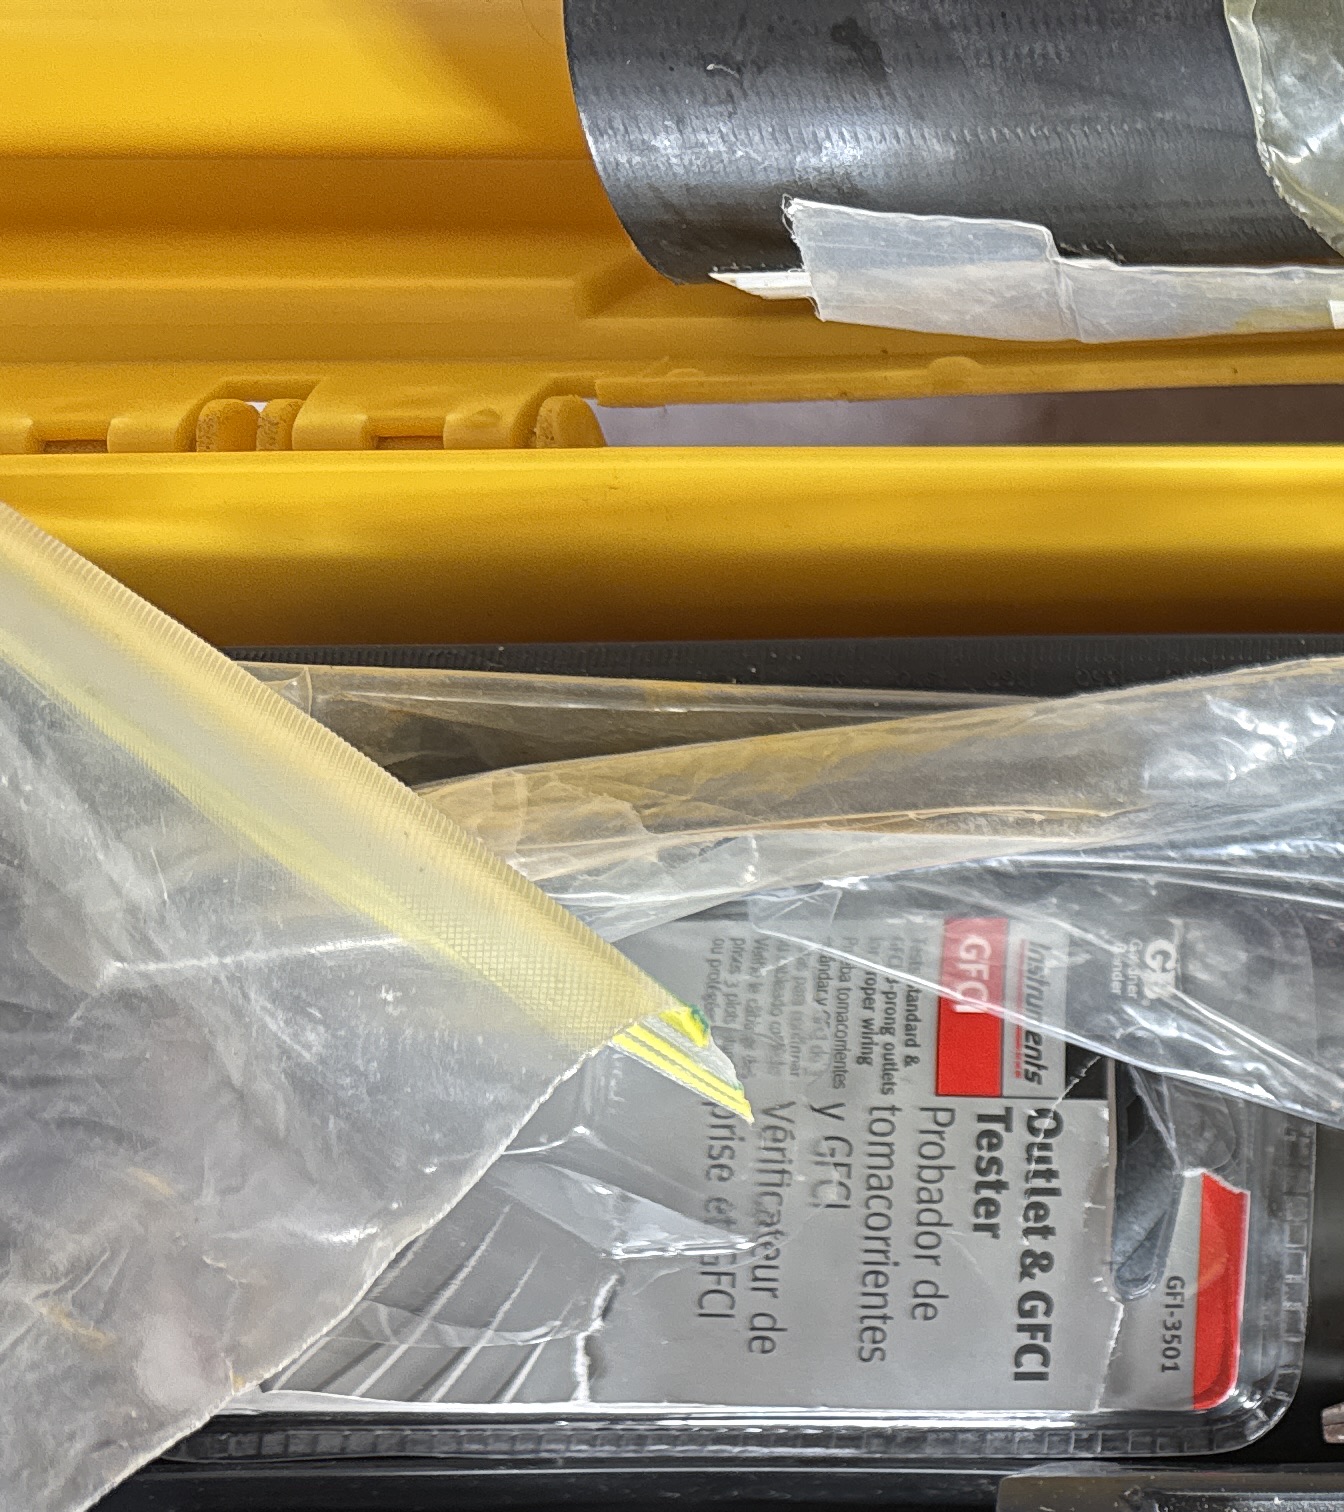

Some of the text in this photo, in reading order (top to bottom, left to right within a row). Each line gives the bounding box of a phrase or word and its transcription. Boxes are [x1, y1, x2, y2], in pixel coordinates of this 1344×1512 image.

[831, 987, 851, 1089] tomacorrientes
[855, 1017, 878, 1066] wiring
[879, 1041, 898, 1095] outlets
[903, 1054, 919, 1068] &
[749, 1101, 795, 1298] Vérificateur
[809, 1102, 853, 1210] y GFCI
[971, 1106, 1012, 1238] Tester
[702, 1196, 736, 1226] et
[857, 1106, 899, 1362] tomacorrientes
[910, 1106, 955, 1321] Probador de
[1012, 1108, 1062, 1382] Outlet & GFCI
[747, 1312, 787, 1355] de
[1159, 1275, 1184, 1373] GFI-3501
